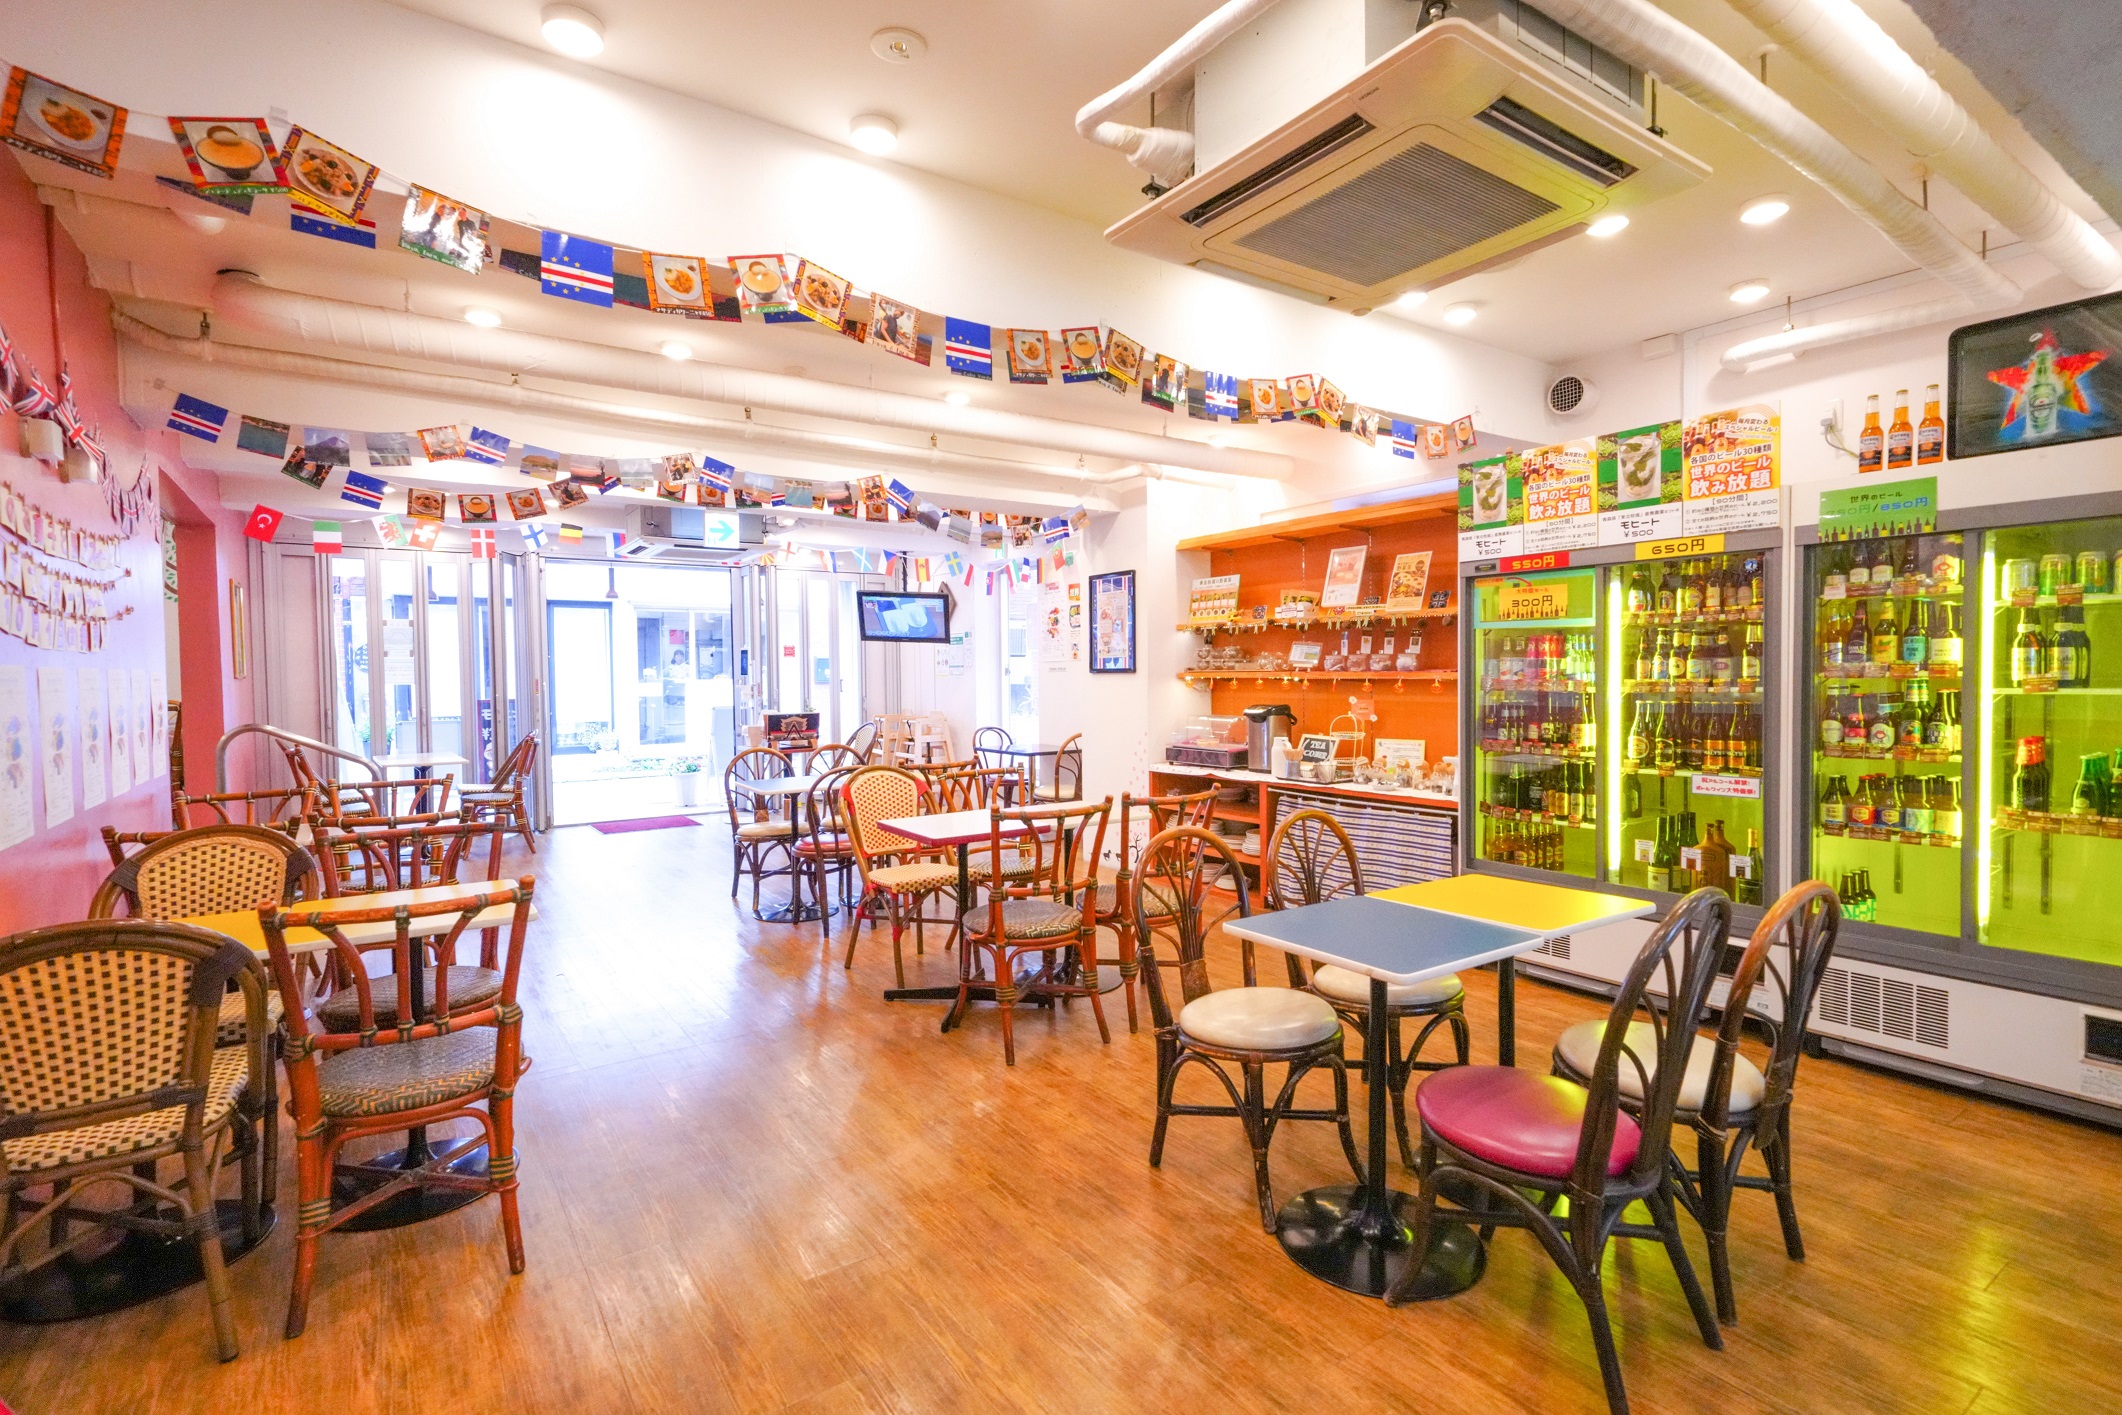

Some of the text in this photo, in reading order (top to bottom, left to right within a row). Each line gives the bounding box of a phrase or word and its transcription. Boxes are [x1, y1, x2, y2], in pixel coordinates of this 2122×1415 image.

[1690, 443, 1772, 465] 各国のビール30種類
[1690, 455, 1771, 479] 世界のビール
[1528, 474, 1591, 491] 各国のビール30種類
[1690, 469, 1771, 497] 飲み放題
[1528, 484, 1591, 505] 世界のビール
[1850, 491, 1903, 504] 世界のビール
[1529, 496, 1591, 520] 飲み放題
[1620, 517, 1660, 530] モヒート
[1623, 529, 1654, 538] ¥500
[1475, 538, 1506, 548] モヒート
[1651, 538, 1704, 555] 650円
[1478, 548, 1502, 556] ¥500
[1511, 555, 1555, 570] 550円
[1511, 594, 1553, 608] 300円
